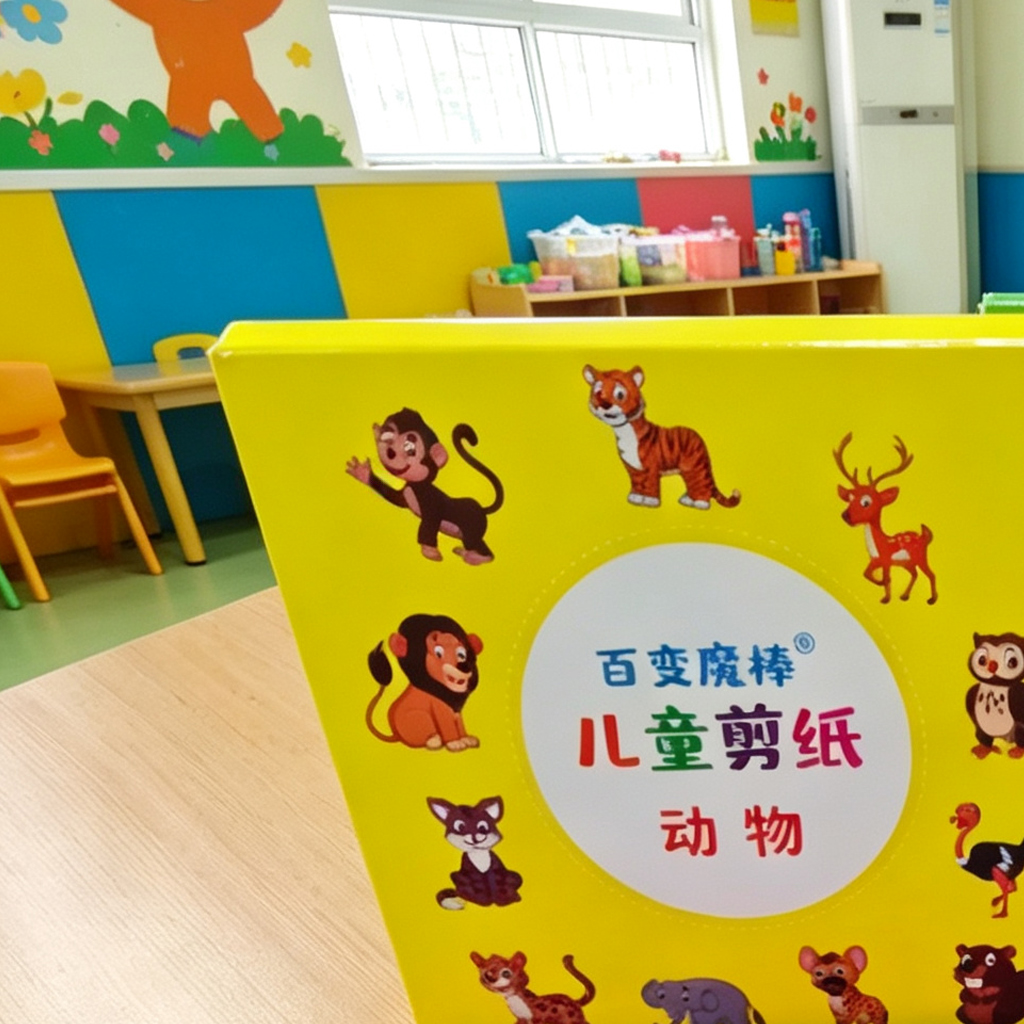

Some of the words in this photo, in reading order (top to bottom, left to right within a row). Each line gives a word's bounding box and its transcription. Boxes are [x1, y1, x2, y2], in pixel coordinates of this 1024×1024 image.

[596, 641, 795, 688] 百变魔棒
[579, 703, 863, 772] 儿童剪纸
[660, 805, 803, 858] 动物
